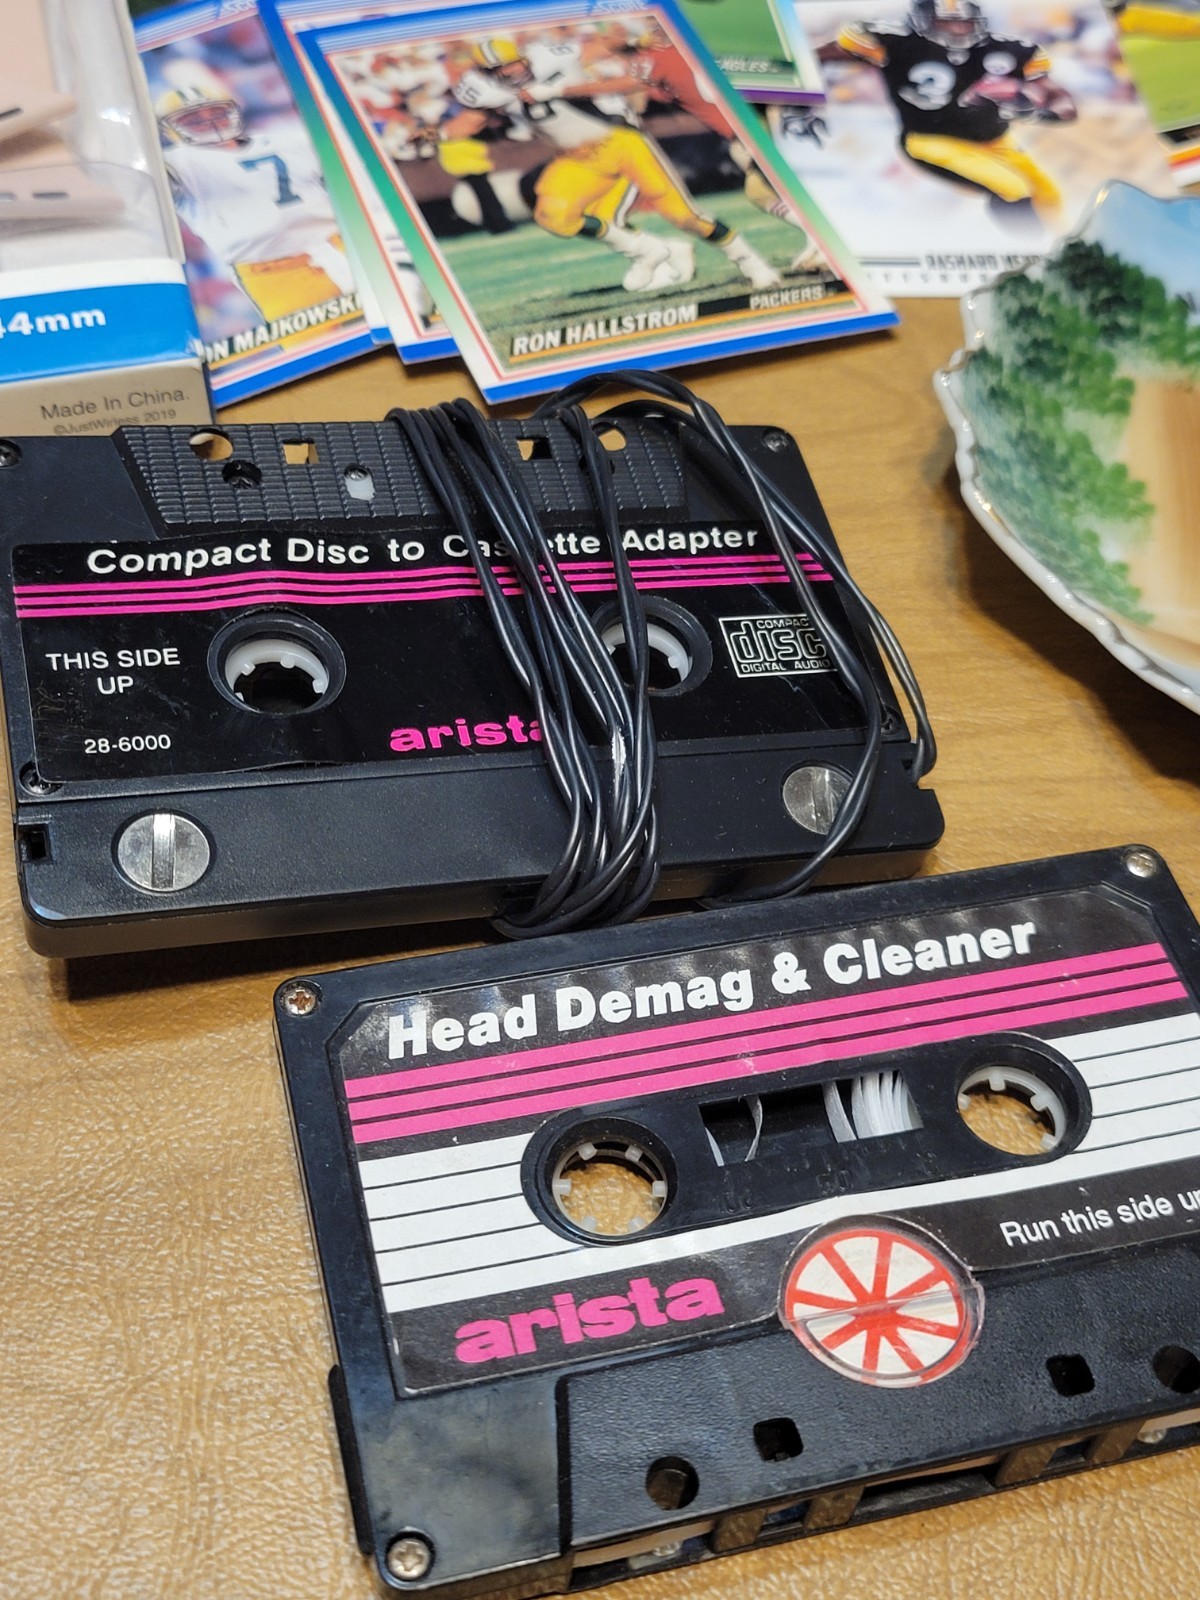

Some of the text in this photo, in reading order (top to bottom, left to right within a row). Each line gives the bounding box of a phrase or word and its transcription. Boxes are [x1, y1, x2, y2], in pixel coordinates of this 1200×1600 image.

[238, 155, 303, 207] 7
[511, 284, 824, 356] RON HALLSTROM PACKERS
[41, 389, 190, 421] Made In China.
[144, 408, 176, 423] 2019
[87, 527, 758, 576] Compact Disc to Castte Adapter
[45, 648, 181, 671] THIS SIDE
[741, 659, 831, 673] DIGITAL AUDIO
[97, 676, 134, 695] UP
[84, 734, 171, 754] 28-6000
[388, 920, 1037, 1060] Head Demag & Cleaner
[999, 1221, 1060, 1247] Run
[1061, 1206, 1114, 1234] this
[1117, 1195, 1175, 1224] side
[454, 1277, 725, 1364] arista
